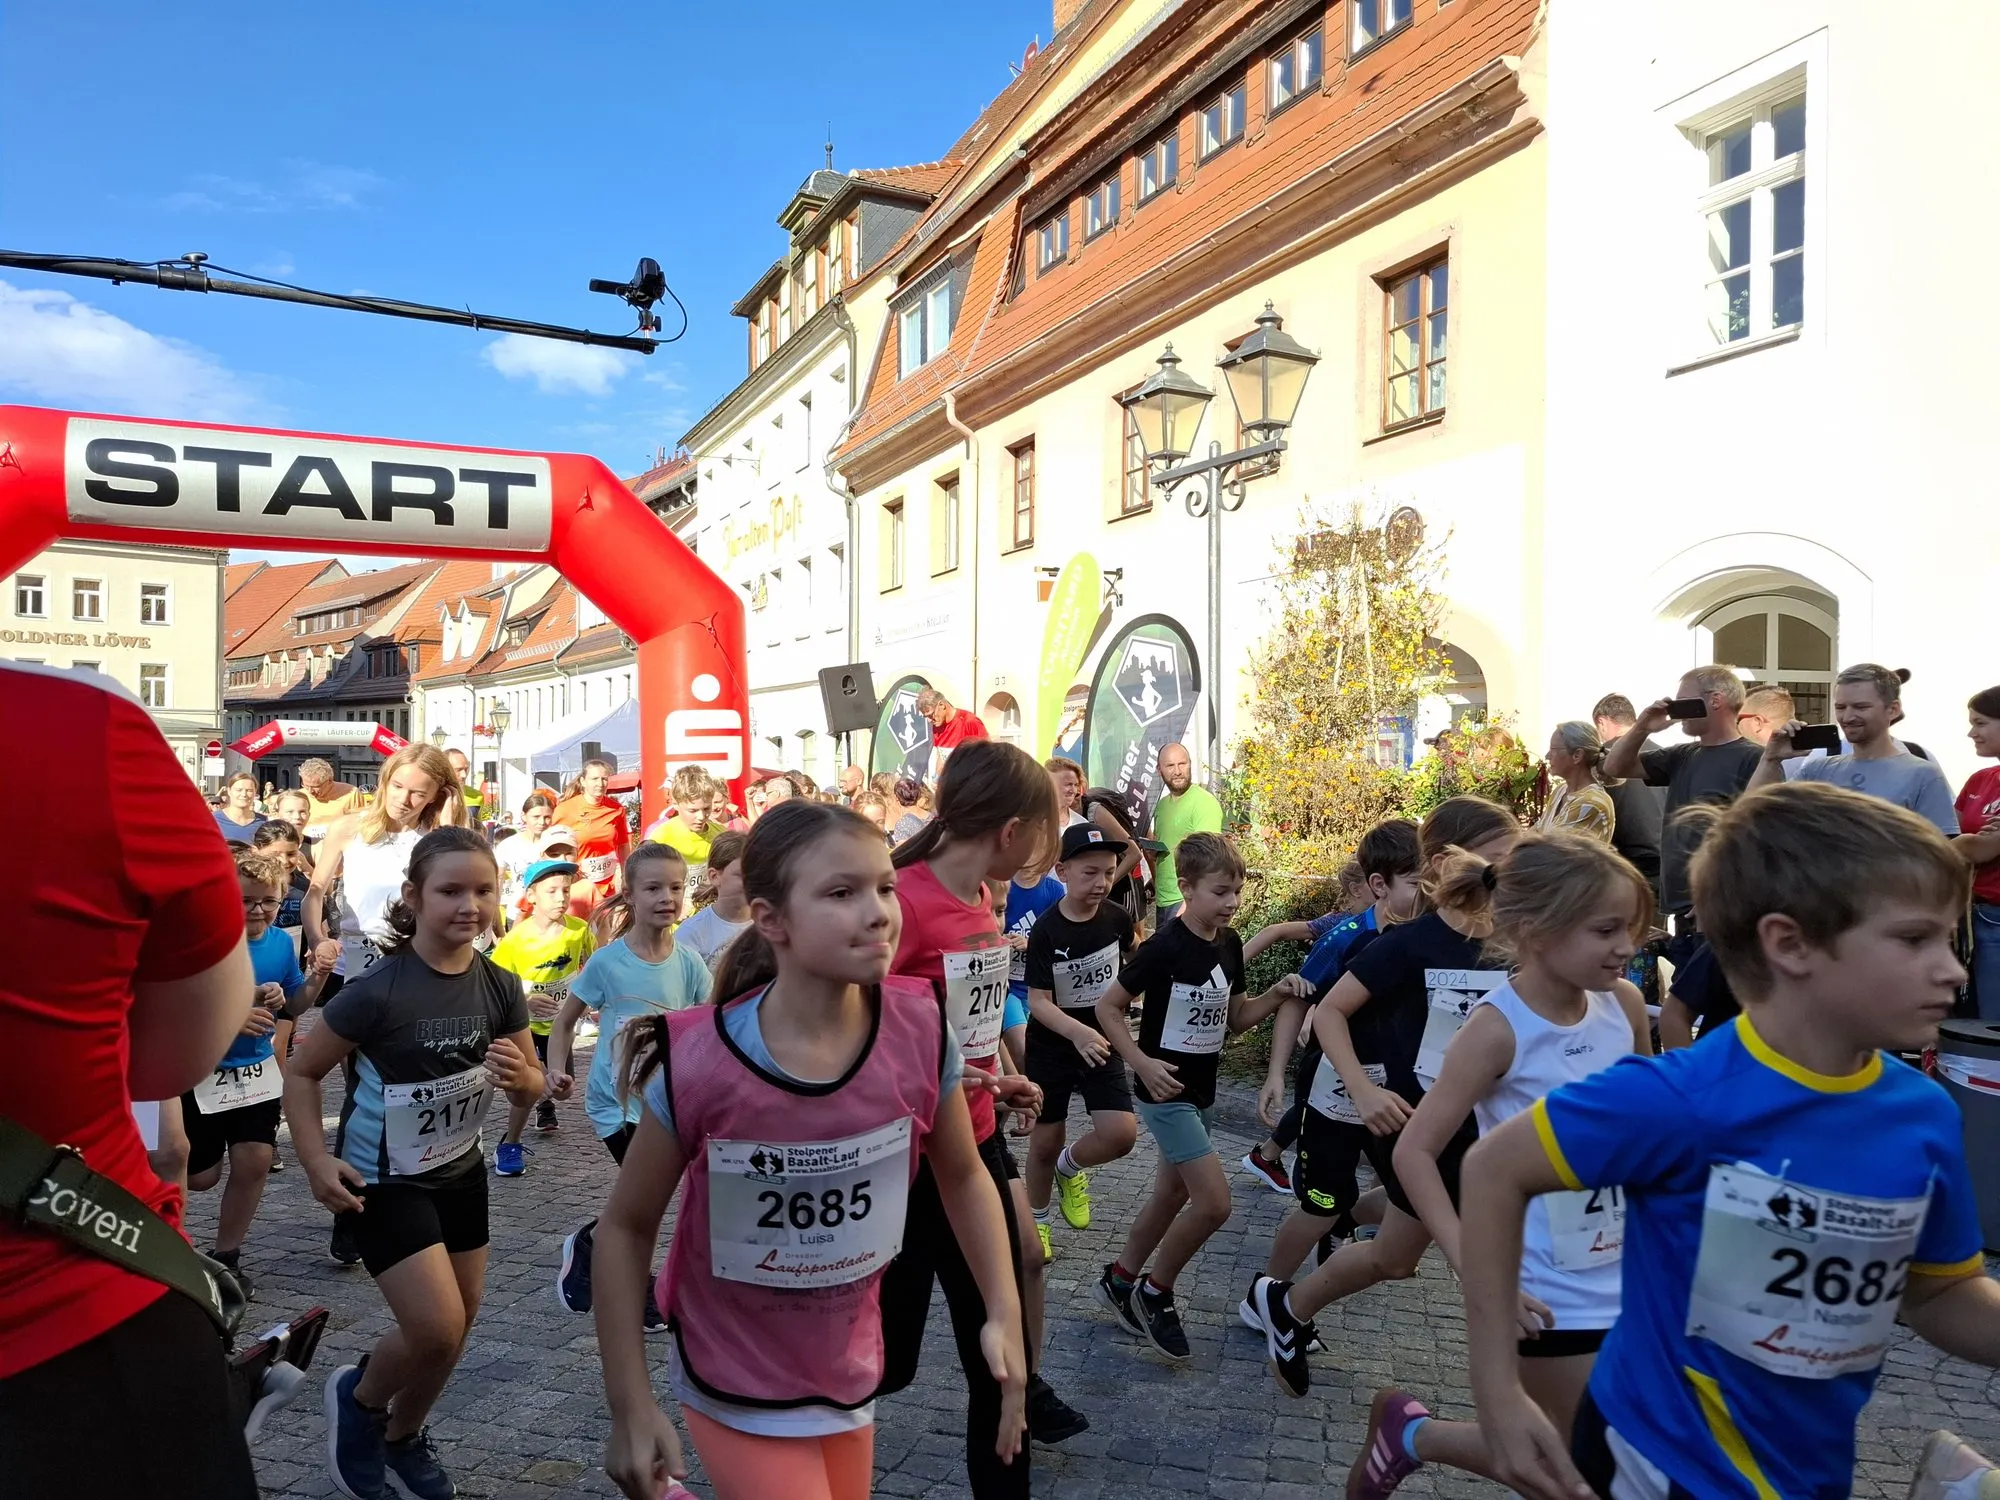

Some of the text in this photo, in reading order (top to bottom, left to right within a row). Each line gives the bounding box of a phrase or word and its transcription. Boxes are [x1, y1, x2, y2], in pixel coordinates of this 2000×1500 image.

[85, 437, 537, 529] START
[93, 632, 151, 649] LÖWE
[1116, 740, 1141, 795] ener
[1071, 963, 1113, 989] 2459
[1427, 971, 1468, 987] 2024
[1187, 1006, 1227, 1027] 2566
[416, 1015, 487, 1042] BELIEVE
[213, 1062, 263, 1087] 2149
[435, 1075, 466, 1087] Stolpener
[435, 1075, 477, 1094] Basalt-Lauf
[418, 1088, 485, 1136] 2177
[787, 1145, 838, 1157] Stolpener
[787, 1147, 861, 1167] Basalt-Lauf
[757, 1179, 872, 1230] 2685
[1825, 1198, 1896, 1216] Stolpener
[1824, 1209, 1919, 1230] Basalt-Lauf
[799, 1233, 835, 1245] Luisa
[755, 1249, 876, 1277] Laufsportladen
[1765, 1247, 1915, 1307] 2682
